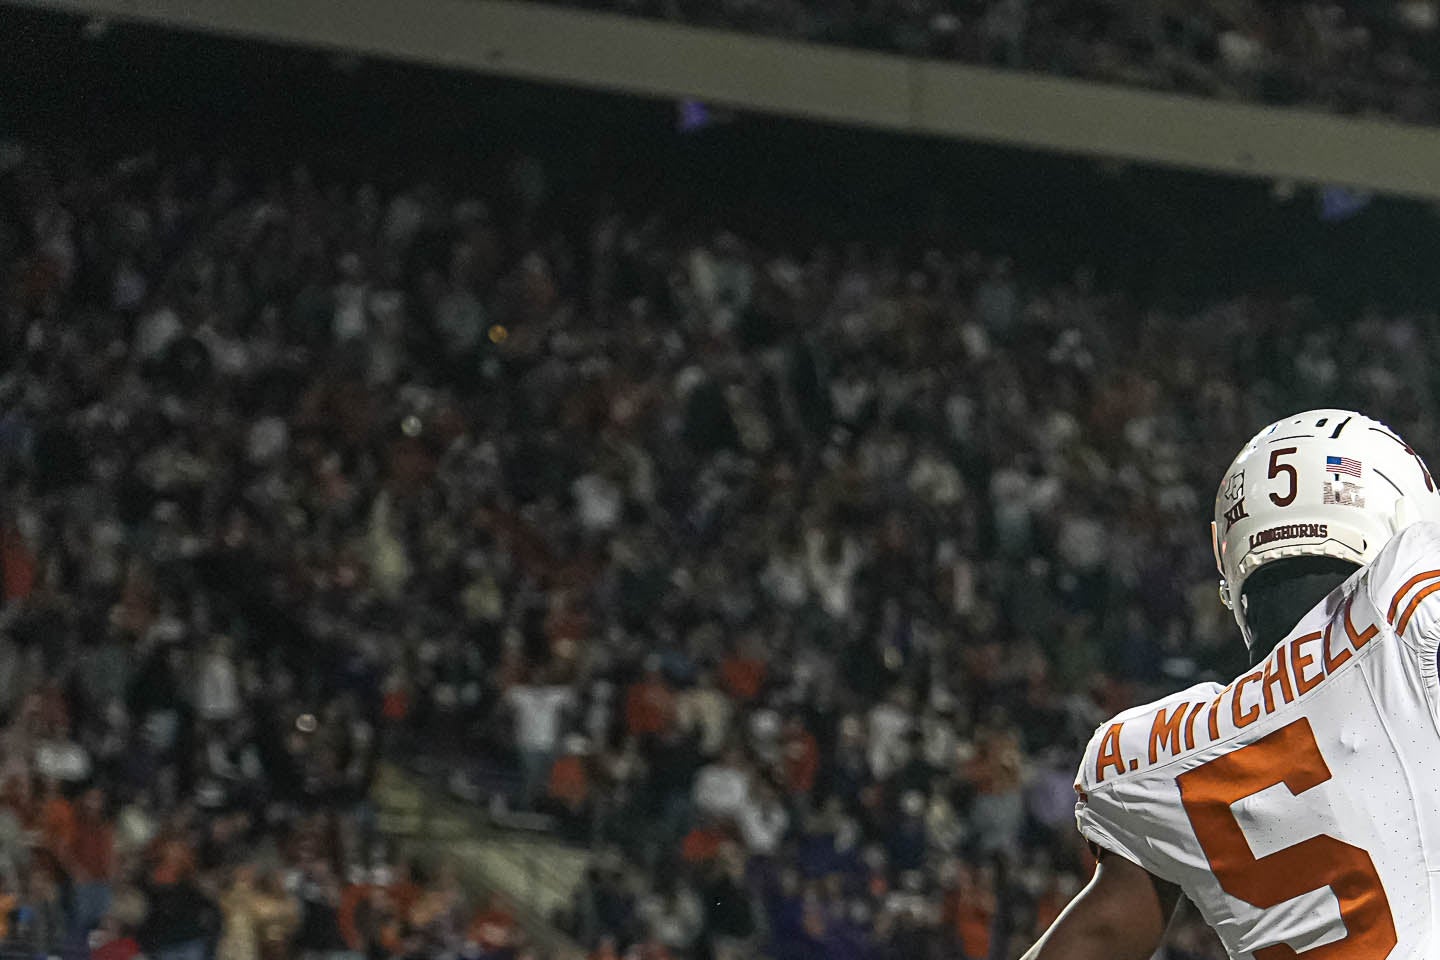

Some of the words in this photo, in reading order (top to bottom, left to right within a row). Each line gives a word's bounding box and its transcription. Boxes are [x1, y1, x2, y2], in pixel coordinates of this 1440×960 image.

[1268, 447, 1297, 507] 5
[1249, 524, 1328, 549] LONGHORNS
[1096, 722, 1139, 783] A.
[1149, 600, 1380, 765] MITCHELL
